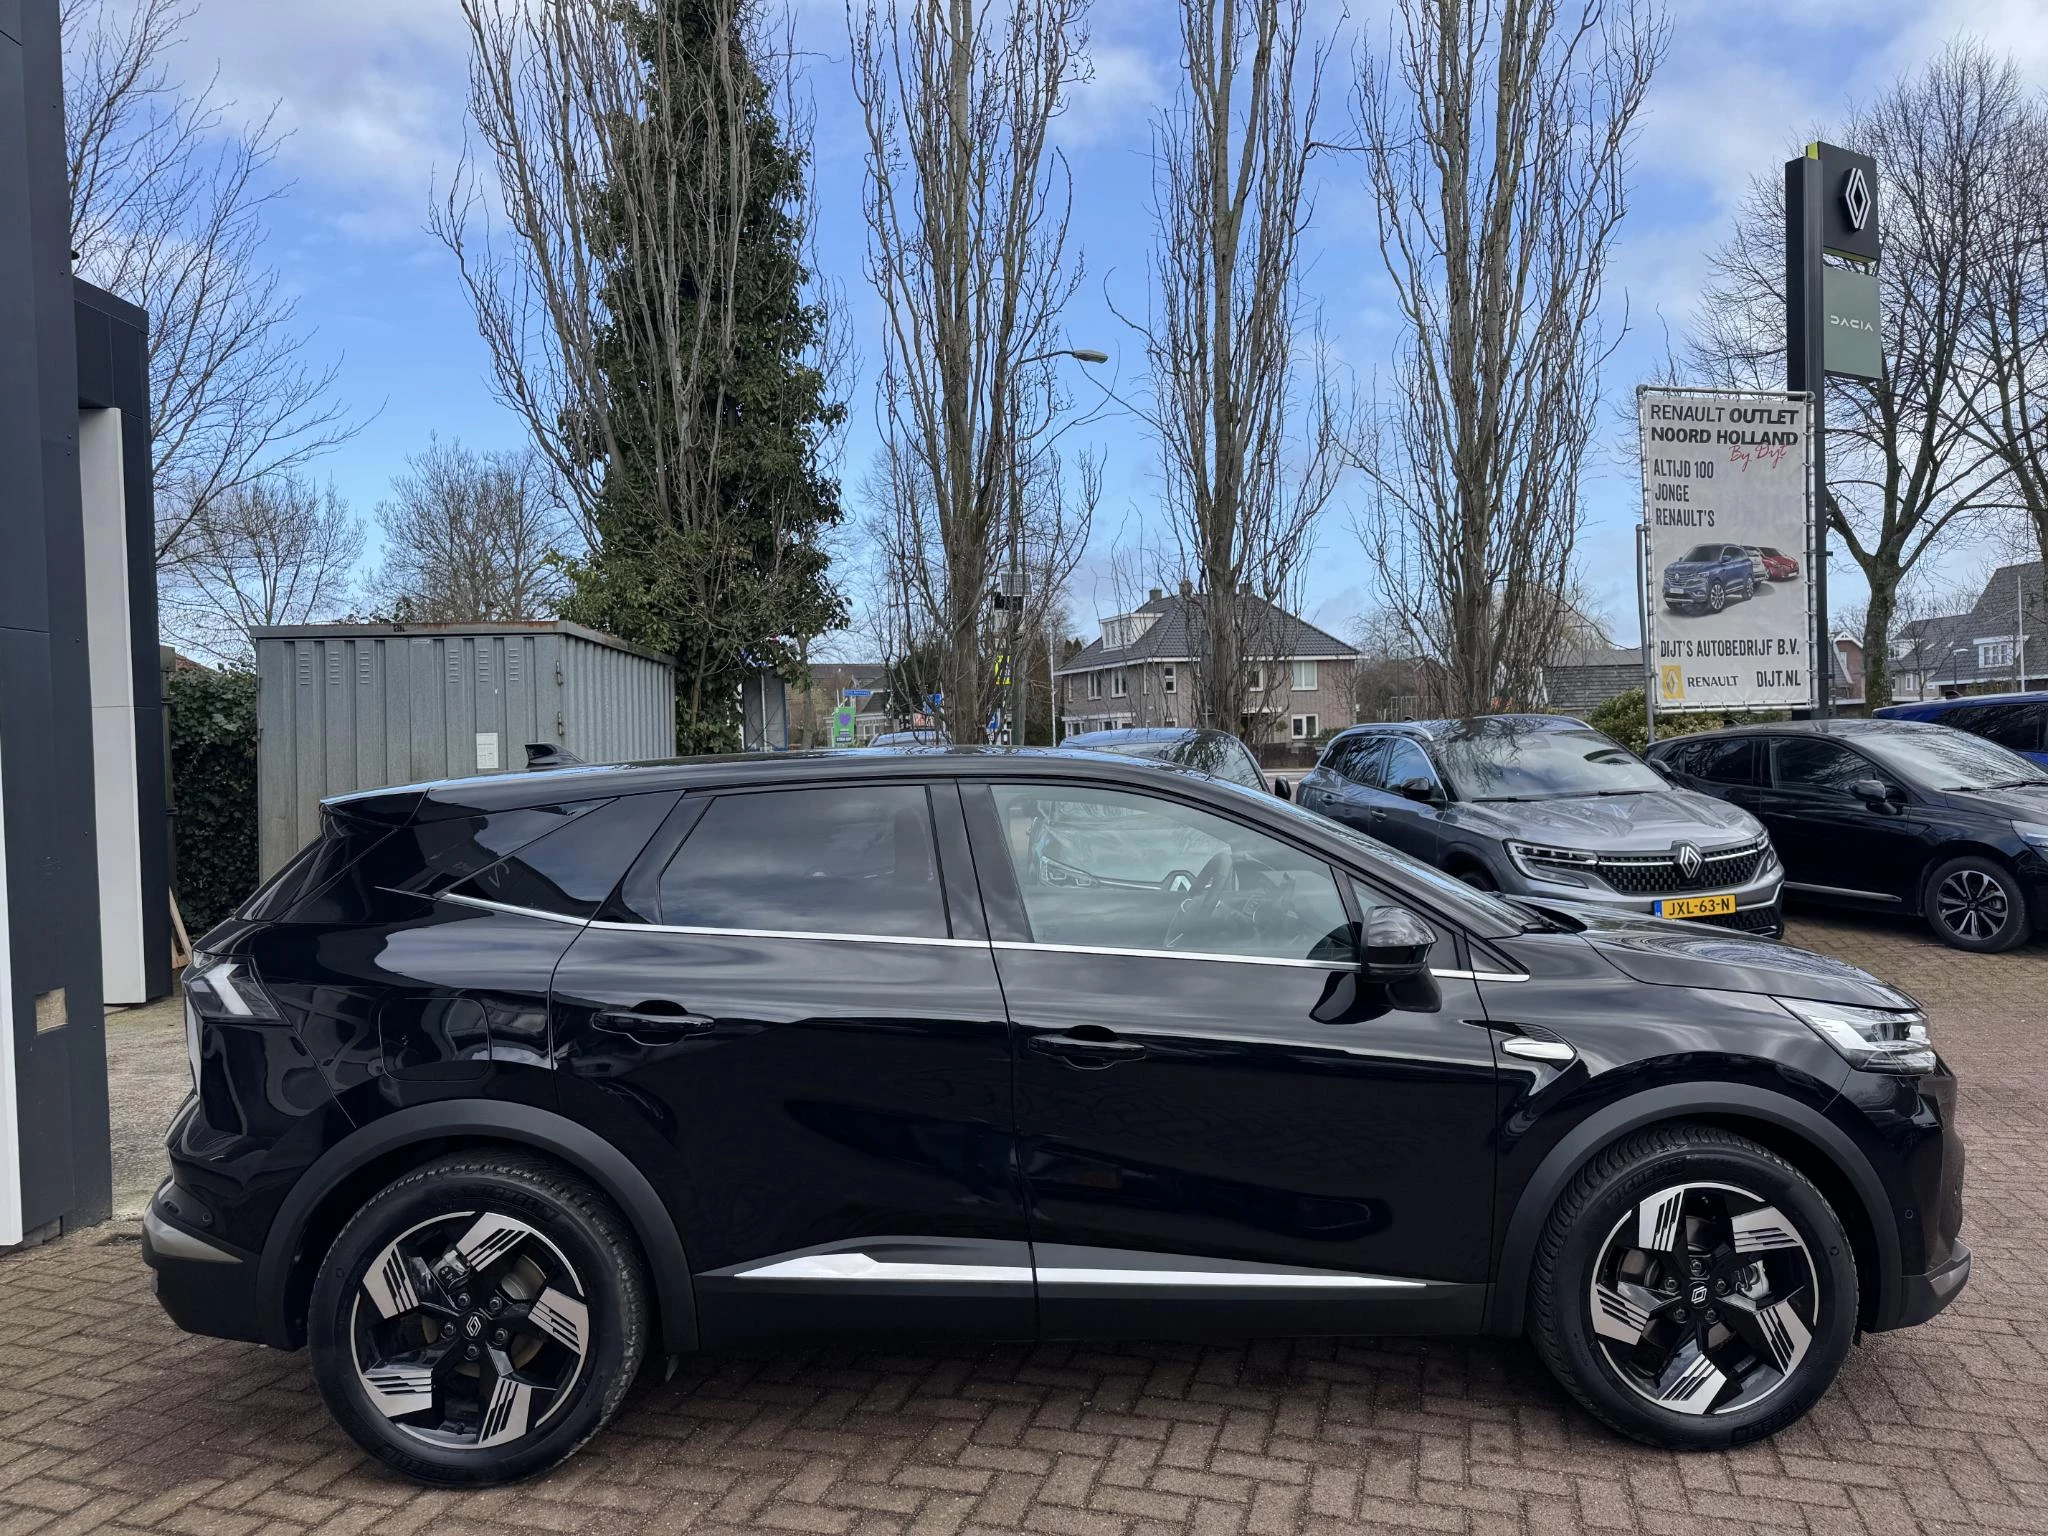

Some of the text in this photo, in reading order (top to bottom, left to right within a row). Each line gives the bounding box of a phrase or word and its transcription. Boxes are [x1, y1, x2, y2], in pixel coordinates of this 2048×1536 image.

[1830, 314, 1873, 332] DACIA
[1650, 404, 1799, 425] RENAULT OUTLET
[1651, 427, 1799, 446] NOORD HOLLAND
[1729, 445, 1752, 472] By
[1653, 458, 1714, 479] ALTIJD 100
[1654, 483, 1690, 502] JONGE
[1655, 507, 1715, 527] RENAULT'S
[1660, 638, 1800, 658] DIJT'S AUTOBEDRIJF B.V.
[1687, 675, 1739, 688] RENAULT
[1756, 670, 1801, 688] DIJT.NL
[1669, 898, 1730, 916] JXL-63-N
